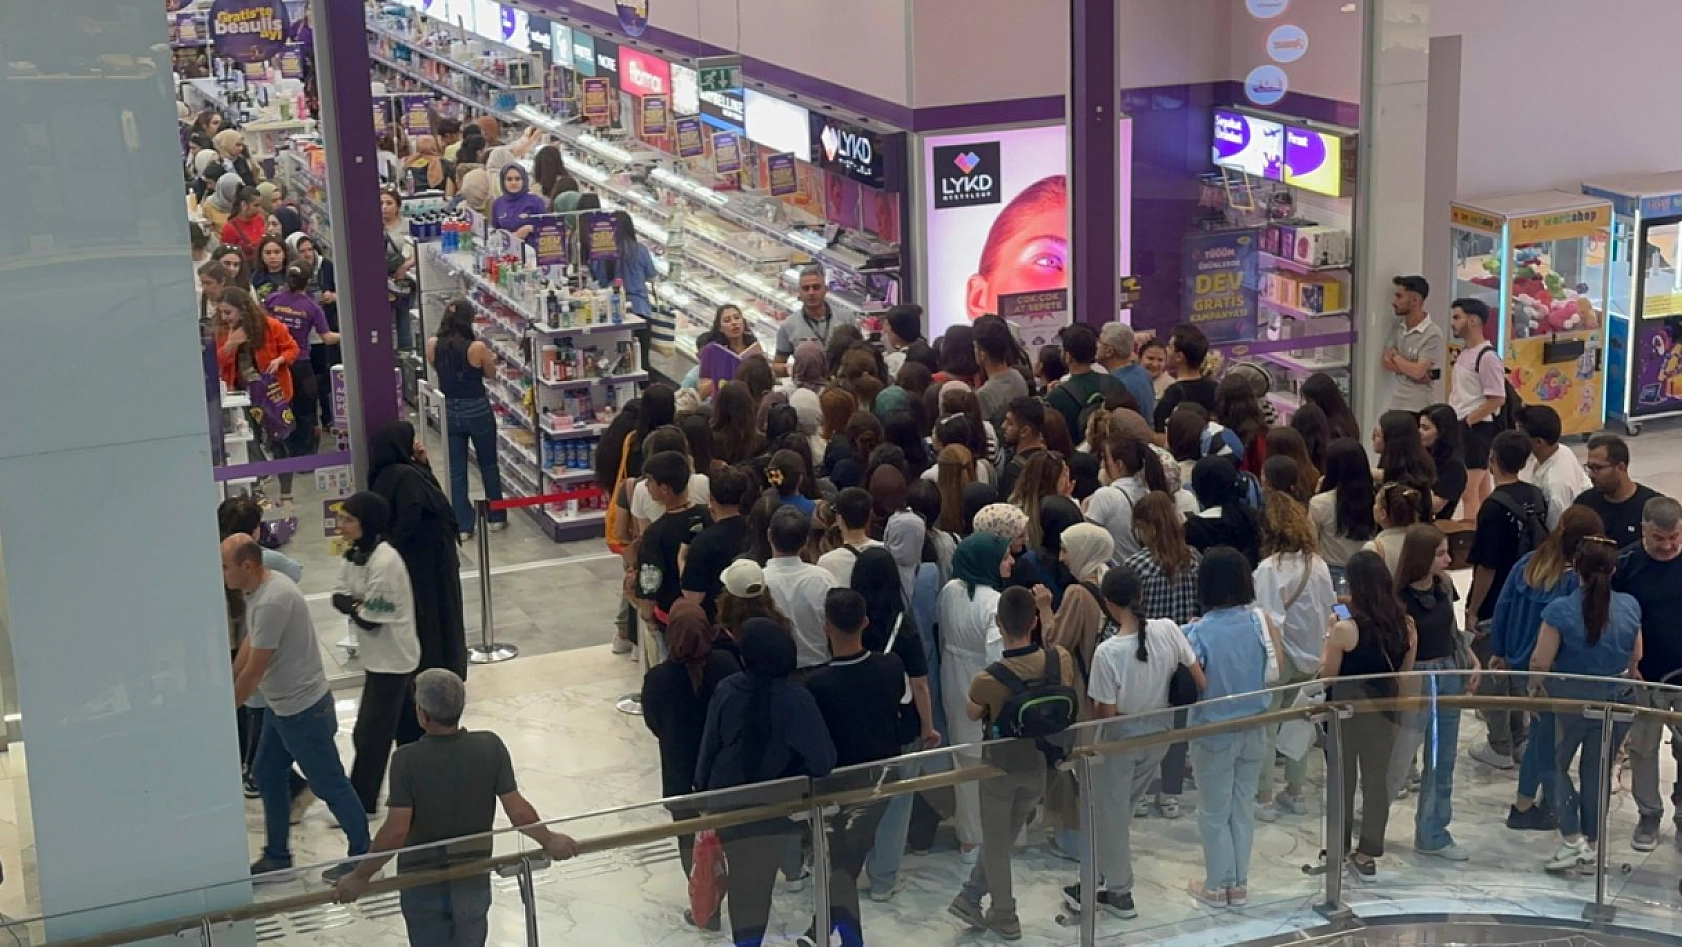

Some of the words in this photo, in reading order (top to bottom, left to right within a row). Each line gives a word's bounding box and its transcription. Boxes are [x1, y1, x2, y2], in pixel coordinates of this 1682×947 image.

[837, 129, 872, 164] LYKD
[941, 174, 993, 194] LYKD
[1195, 271, 1244, 294] DEV
[1194, 293, 1245, 311] GRATİS
